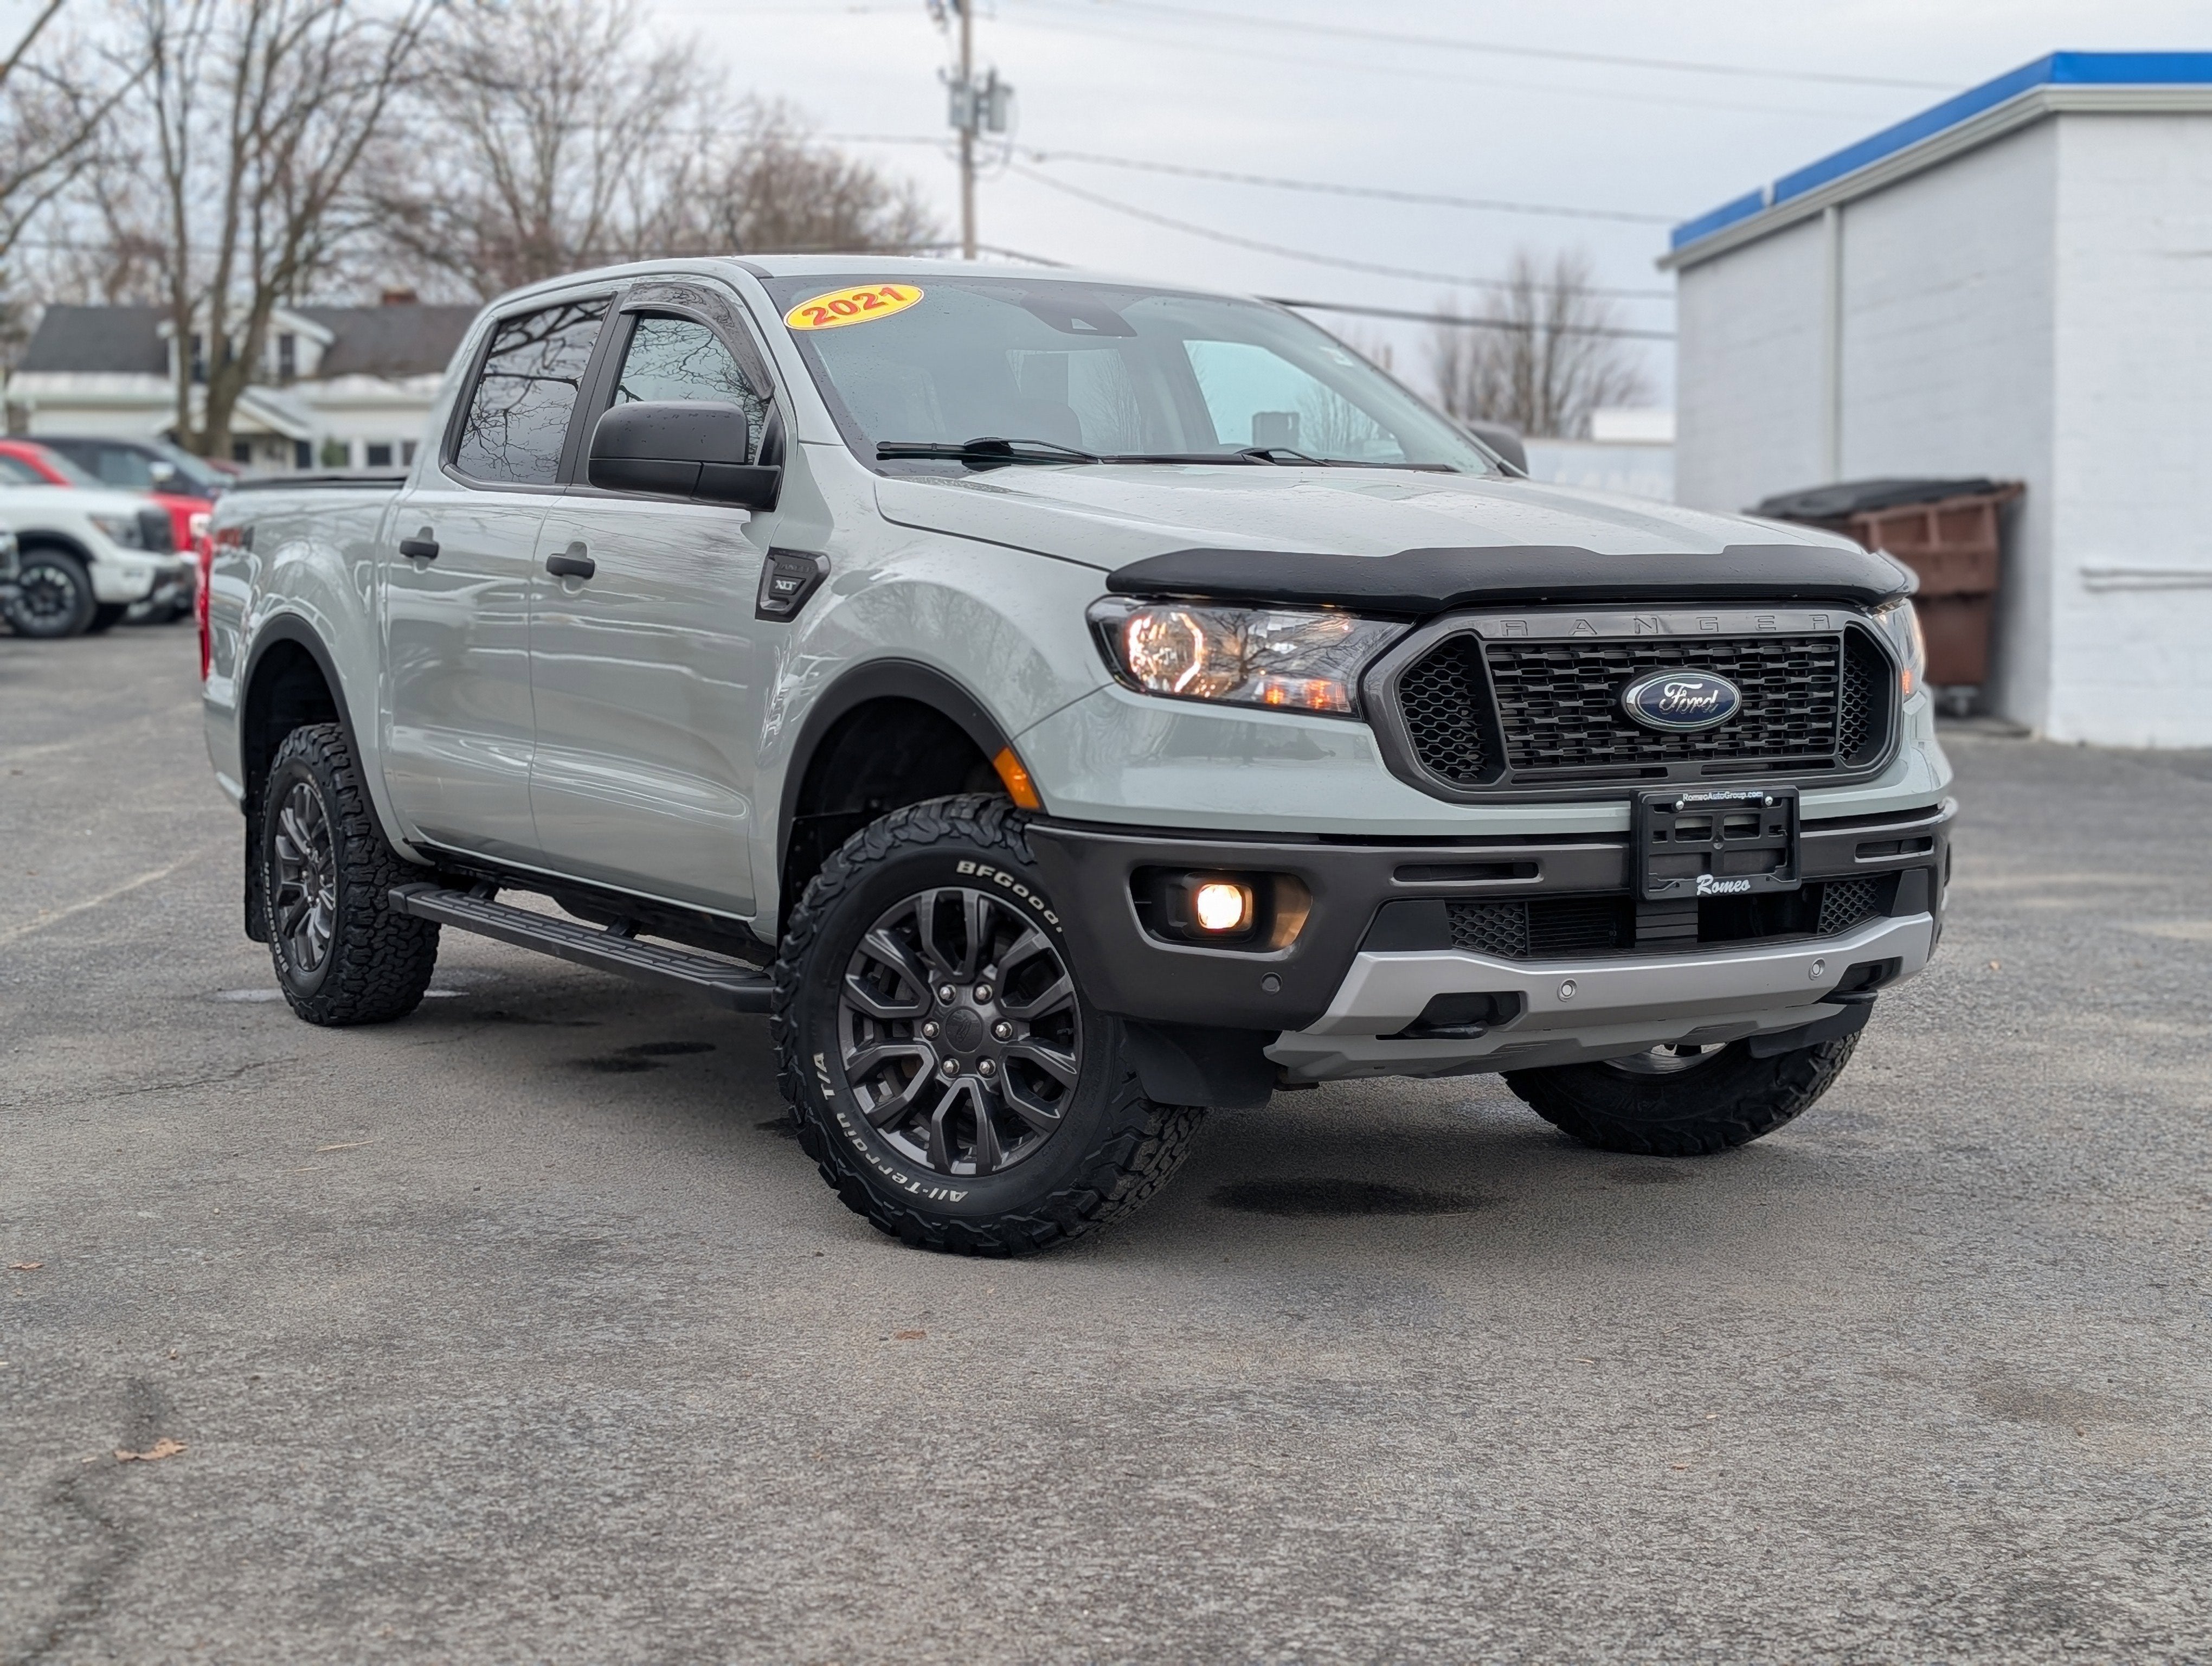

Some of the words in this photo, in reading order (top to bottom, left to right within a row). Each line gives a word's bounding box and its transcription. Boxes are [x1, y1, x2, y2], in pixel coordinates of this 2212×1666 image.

[802, 287, 908, 325] 2021
[775, 580, 797, 591] XLT
[1500, 614, 1830, 636] RANGER
[1659, 682, 1719, 714] Ford
[956, 860, 1062, 933] BFGood
[1696, 874, 1751, 895] Romeo
[814, 1053, 835, 1100] T/A
[837, 1113, 968, 1202] All-Terrain
